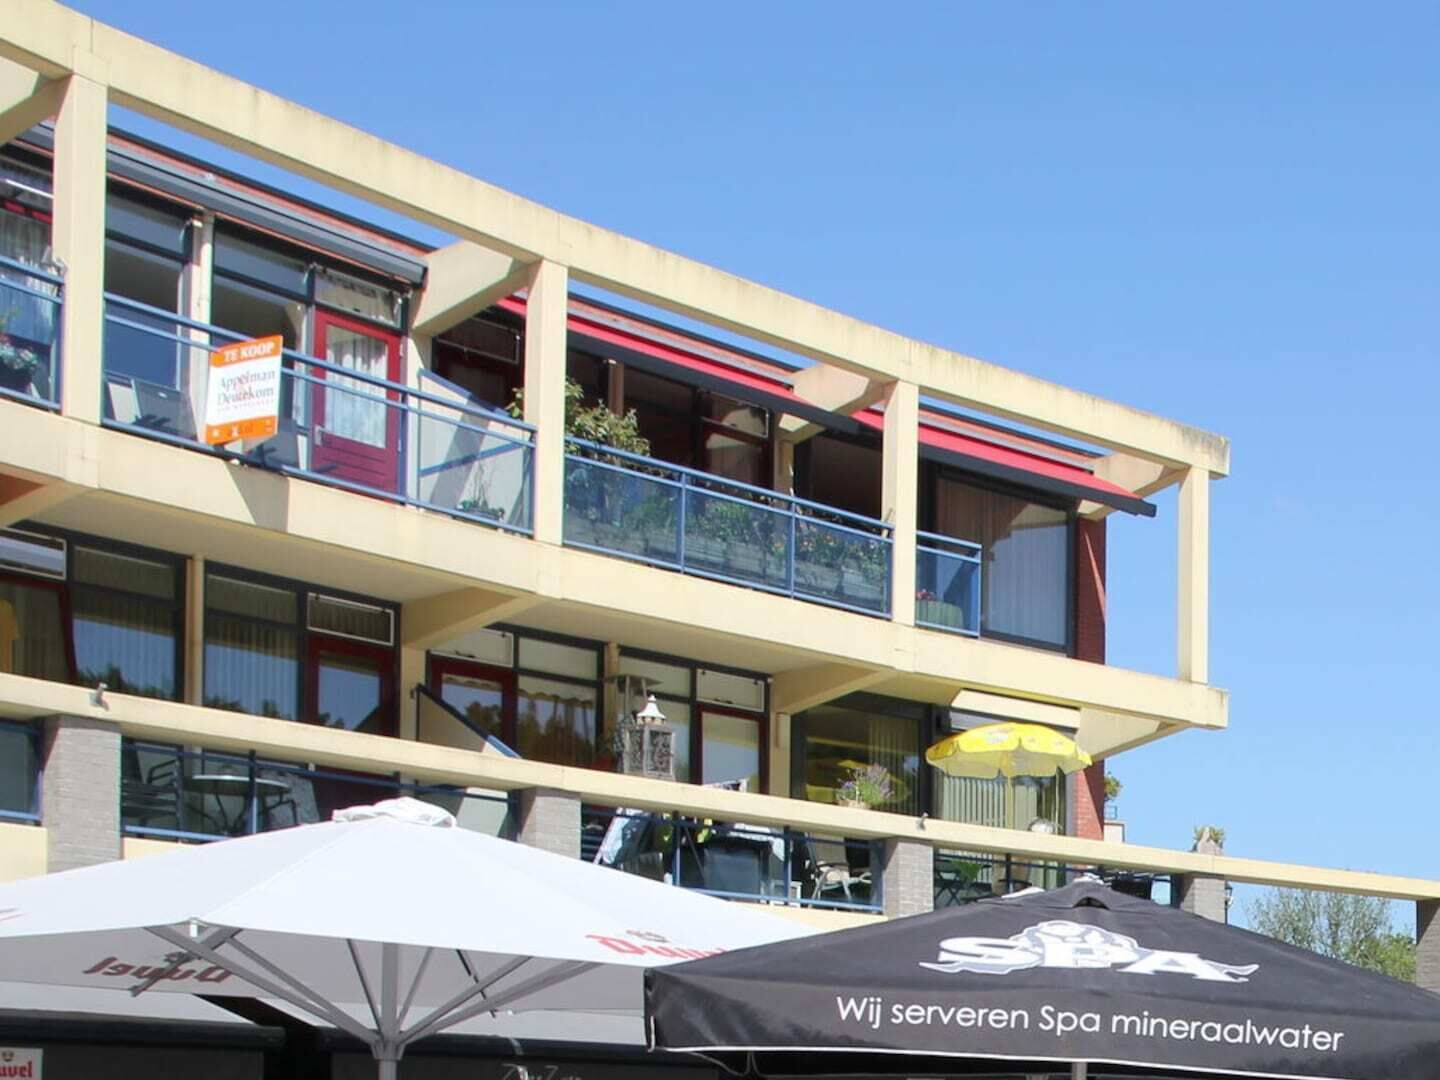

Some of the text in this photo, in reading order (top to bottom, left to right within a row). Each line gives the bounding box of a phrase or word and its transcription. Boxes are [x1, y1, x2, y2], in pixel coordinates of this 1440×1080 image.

[585, 933, 729, 959] Duv
[937, 935, 1250, 983] SPA
[836, 995, 1345, 1052] Wij serveren Spa mineraalwater
